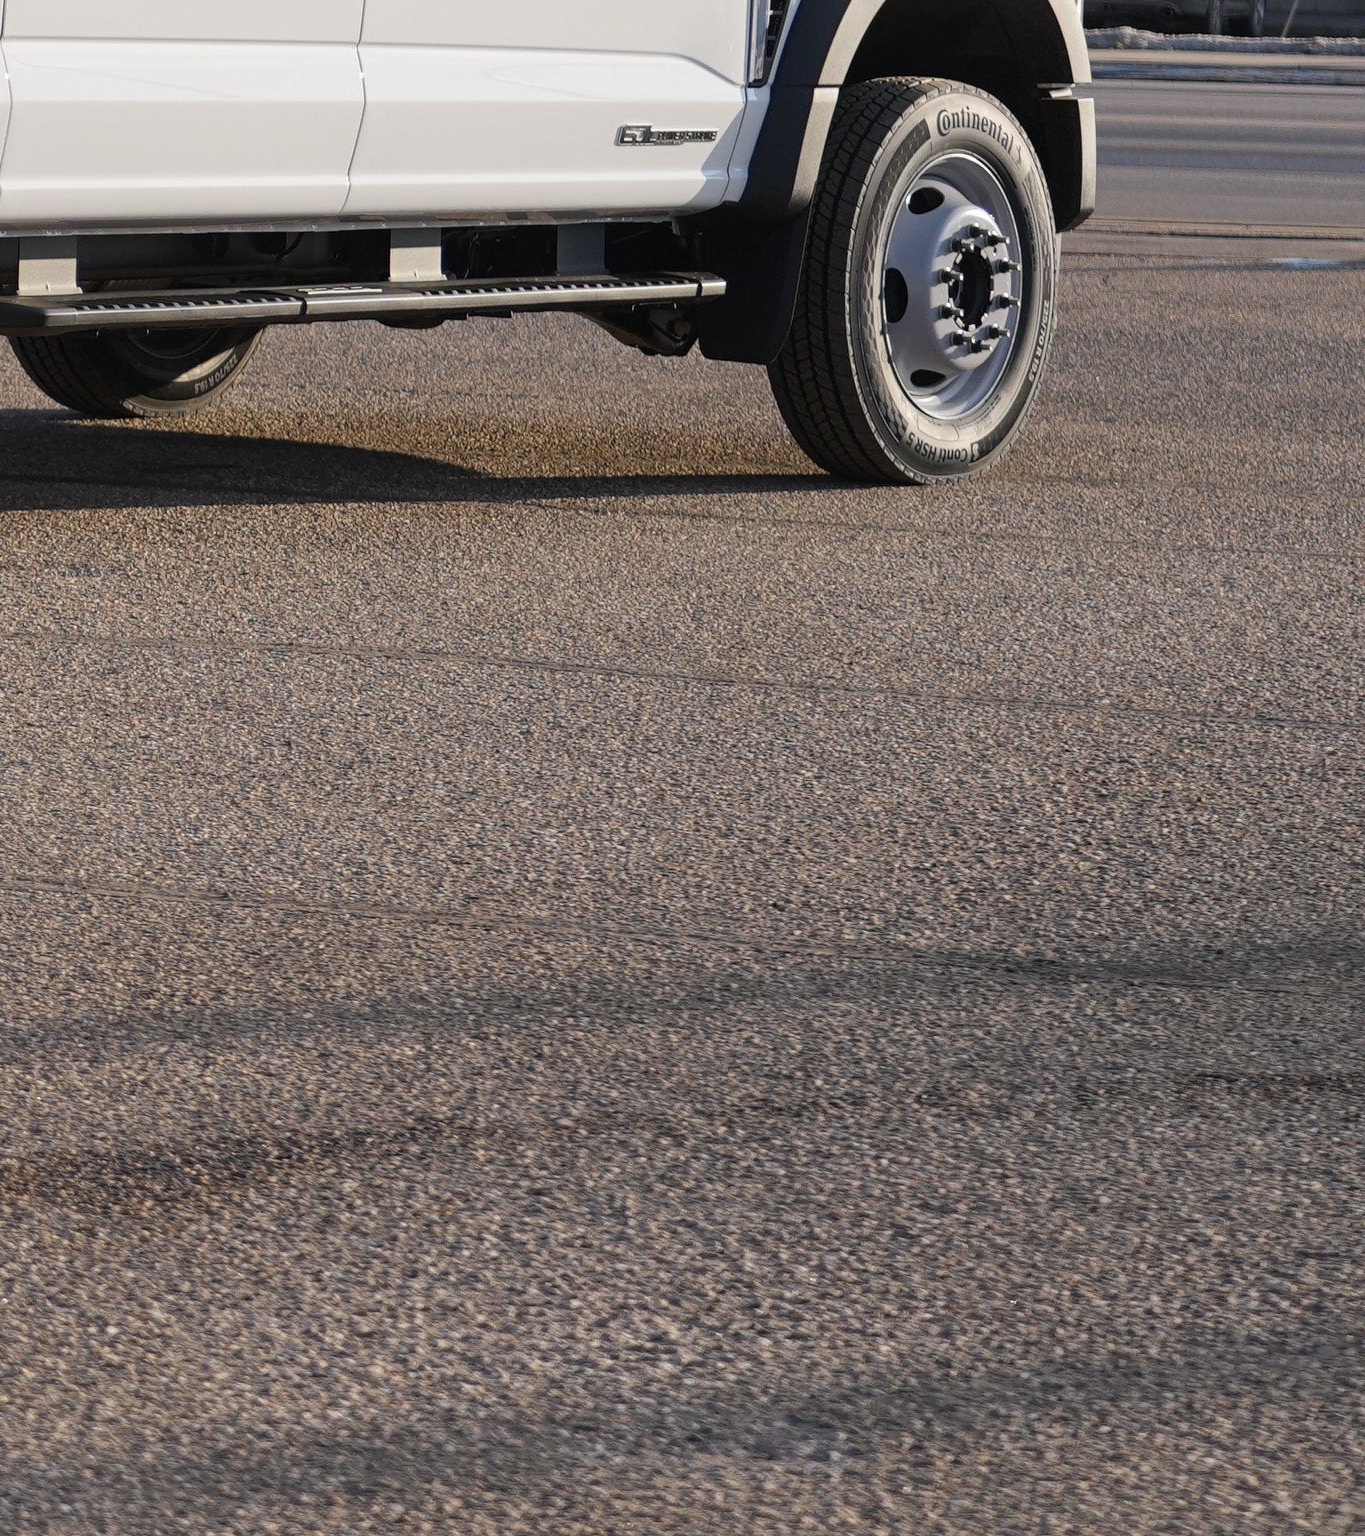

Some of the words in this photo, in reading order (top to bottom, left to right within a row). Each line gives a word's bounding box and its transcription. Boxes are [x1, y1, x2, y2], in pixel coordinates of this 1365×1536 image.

[937, 106, 1014, 154] Continental
[907, 432, 916, 444] 5
[914, 436, 937, 461] HSR
[938, 448, 968, 463] Conti
